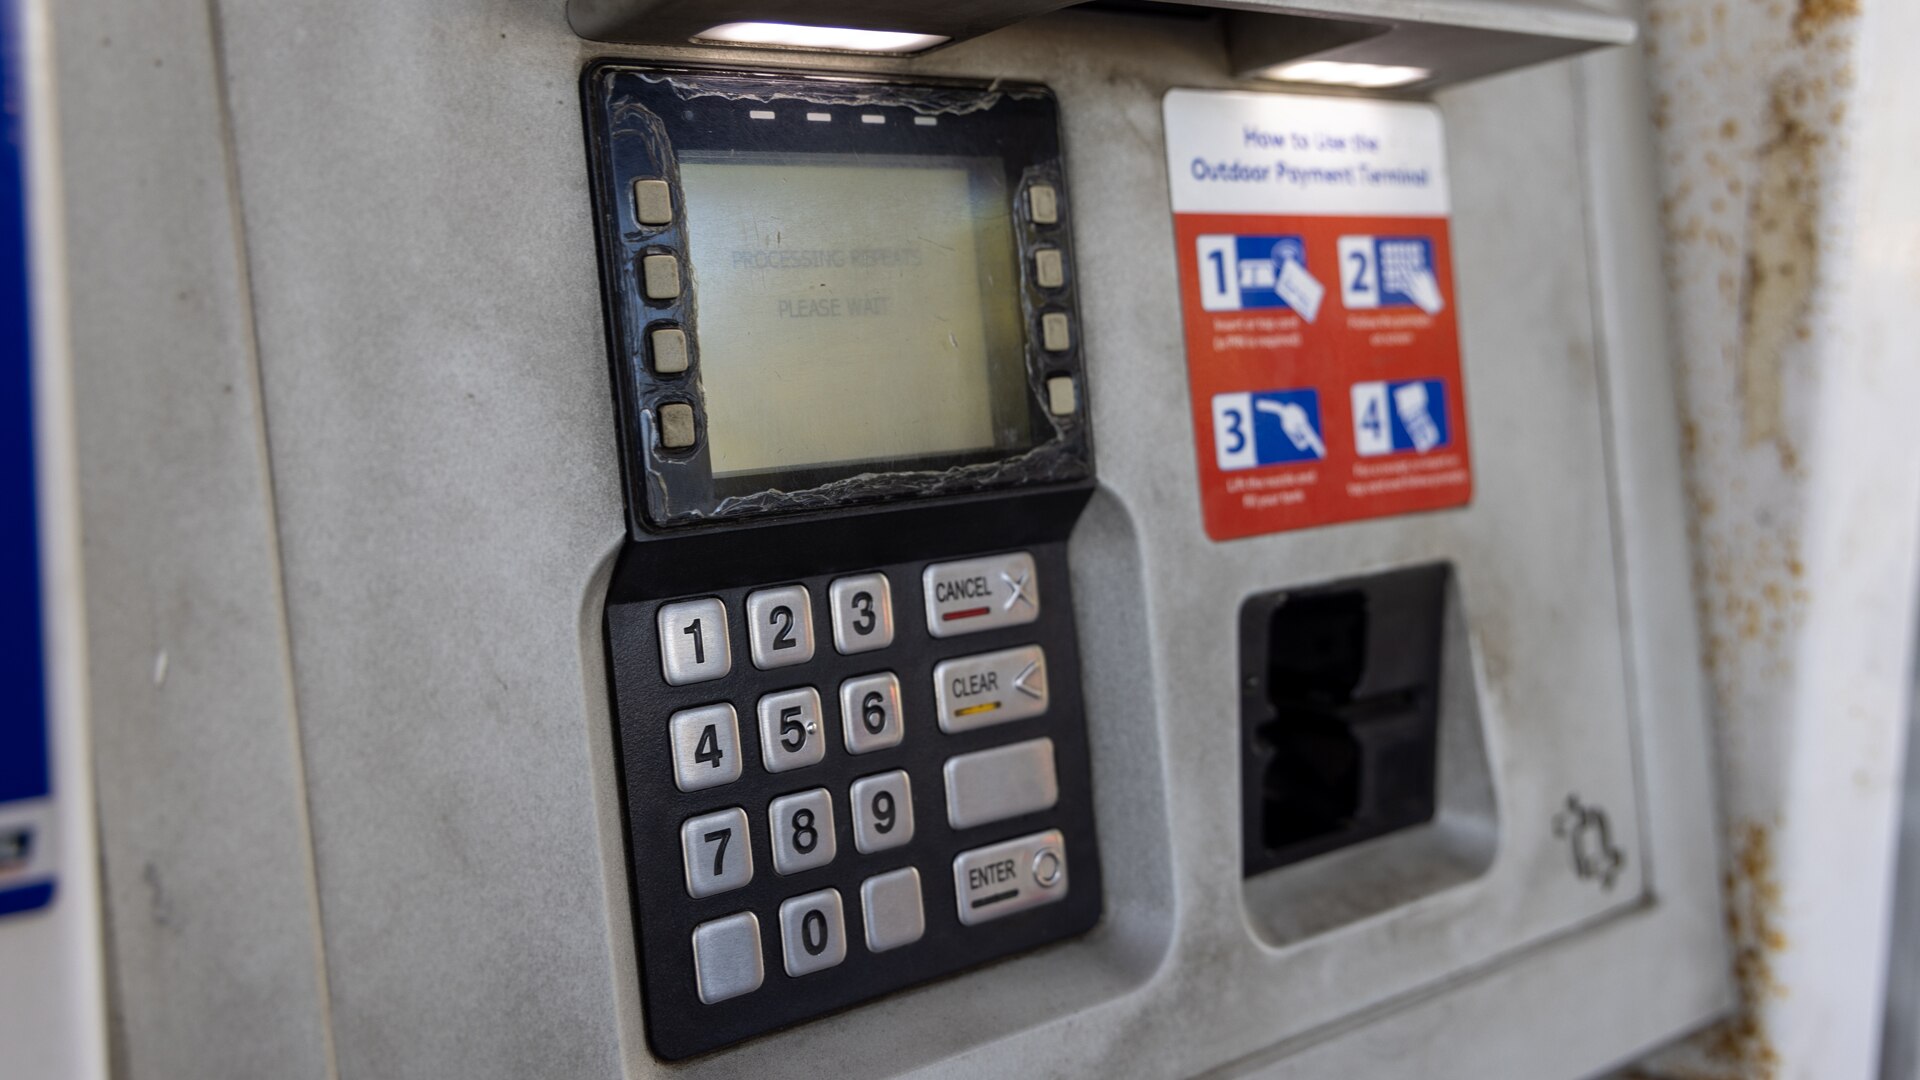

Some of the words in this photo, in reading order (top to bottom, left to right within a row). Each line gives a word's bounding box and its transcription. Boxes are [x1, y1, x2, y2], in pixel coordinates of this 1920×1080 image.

[1242, 128, 1285, 149] How
[1291, 131, 1309, 150] to
[1353, 132, 1380, 152] the
[1191, 158, 1270, 182] Outdoor
[1275, 160, 1355, 189] Payment
[1358, 162, 1430, 188] Terminal
[732, 249, 846, 270] PROCESSING
[1208, 249, 1227, 295] 1
[1349, 251, 1370, 293] 2
[778, 298, 842, 318] PLEASE
[847, 297, 891, 317] WAIT
[1222, 408, 1246, 454] 3
[1361, 397, 1381, 439] 4
[936, 576, 992, 602] CANCEL
[769, 605, 797, 650] 2
[851, 591, 876, 635] 3
[684, 618, 705, 663] 1
[952, 671, 999, 698] CLEAR
[780, 706, 806, 752] 5
[862, 691, 886, 734] 6
[695, 724, 723, 768] 4
[792, 808, 818, 854] 8
[872, 790, 896, 834] 9
[705, 828, 732, 876] 7
[969, 859, 1016, 890] ENTER
[802, 909, 828, 956] 0
